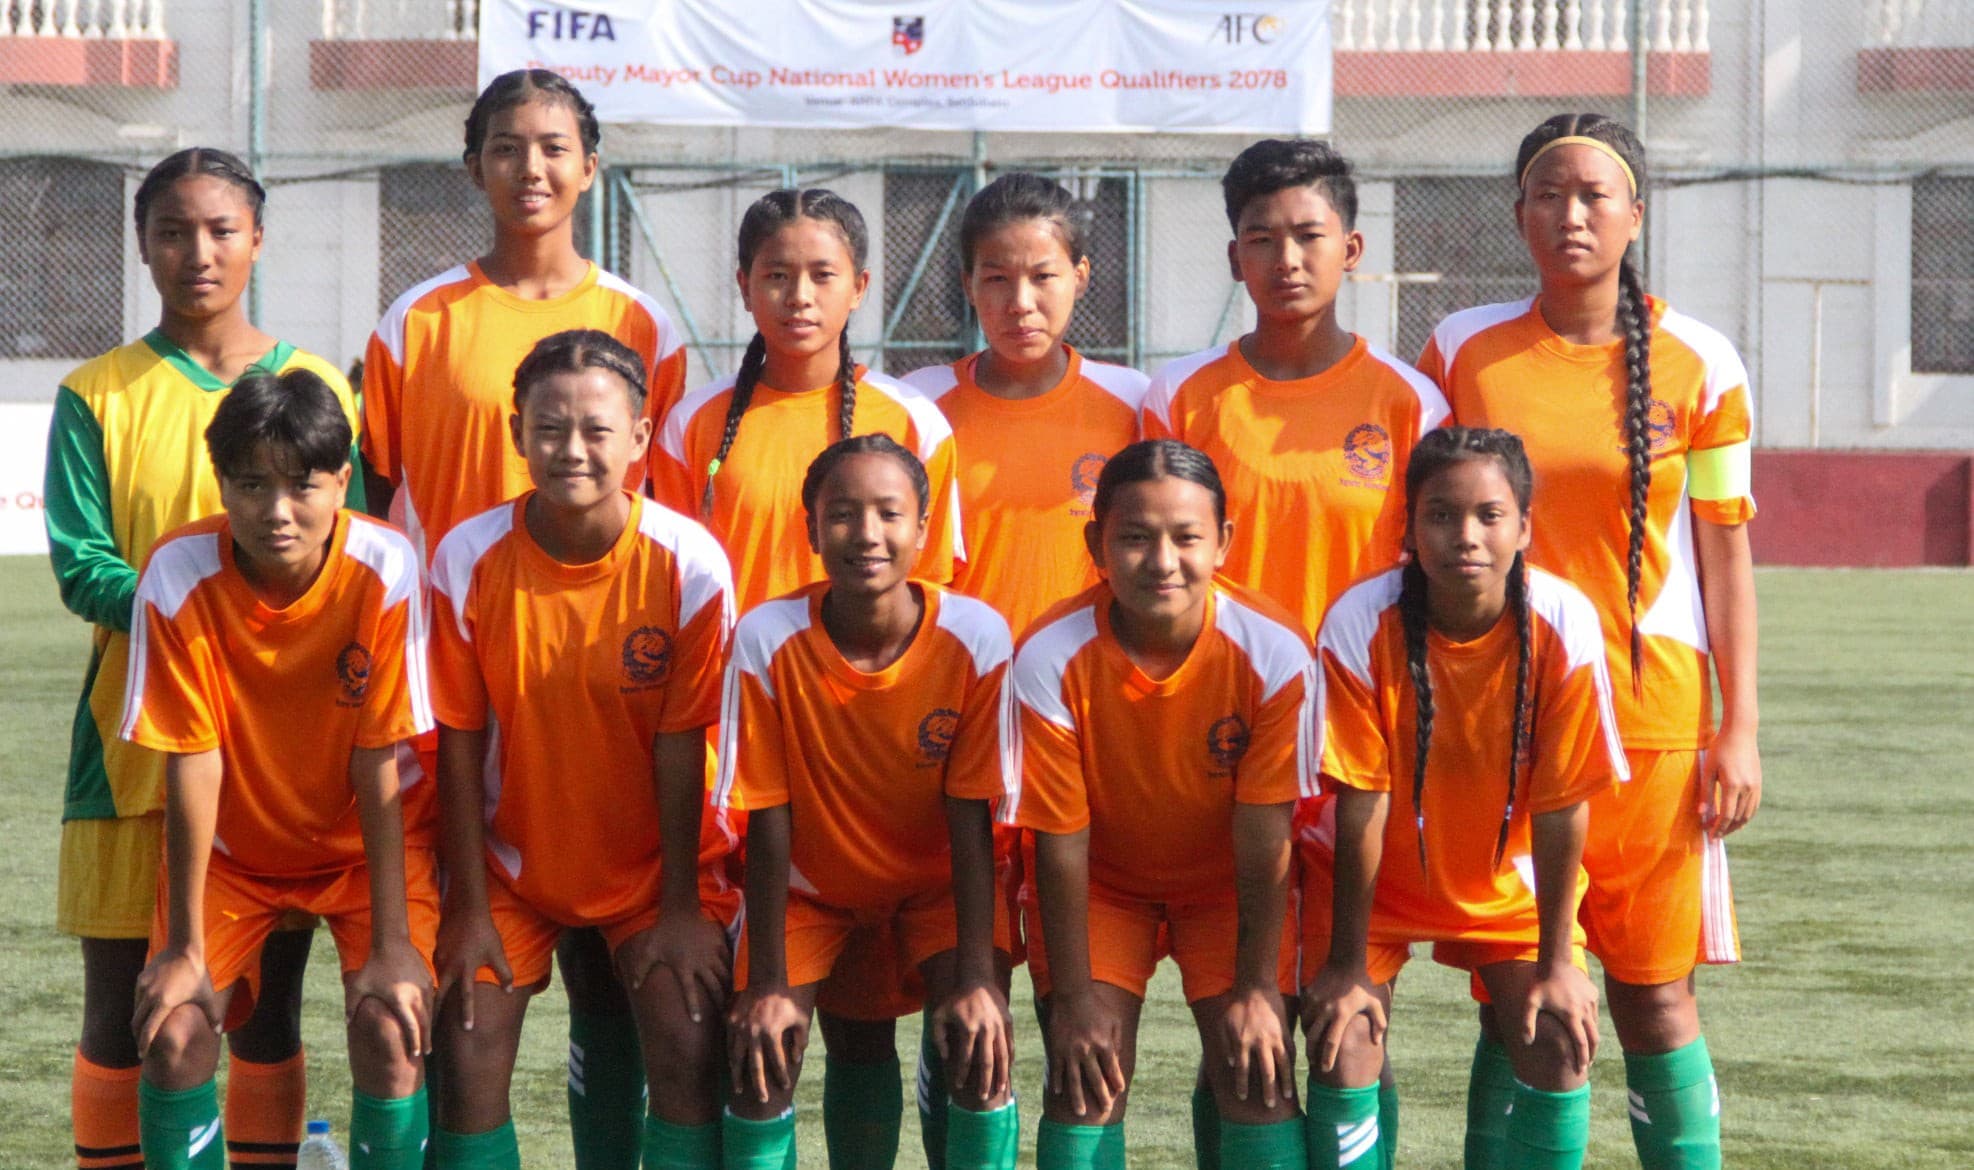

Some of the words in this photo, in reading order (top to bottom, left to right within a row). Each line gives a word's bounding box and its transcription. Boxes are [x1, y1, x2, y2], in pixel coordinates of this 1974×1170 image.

[528, 11, 615, 40] FIFA
[1208, 13, 1281, 45] AFC
[625, 64, 702, 87] Mayor
[710, 65, 761, 88] Cup
[769, 67, 876, 88] National
[884, 68, 995, 90] Women's
[1002, 70, 1092, 93] League
[1100, 69, 1221, 90] Qualifiers
[1229, 70, 1288, 90] 2078
